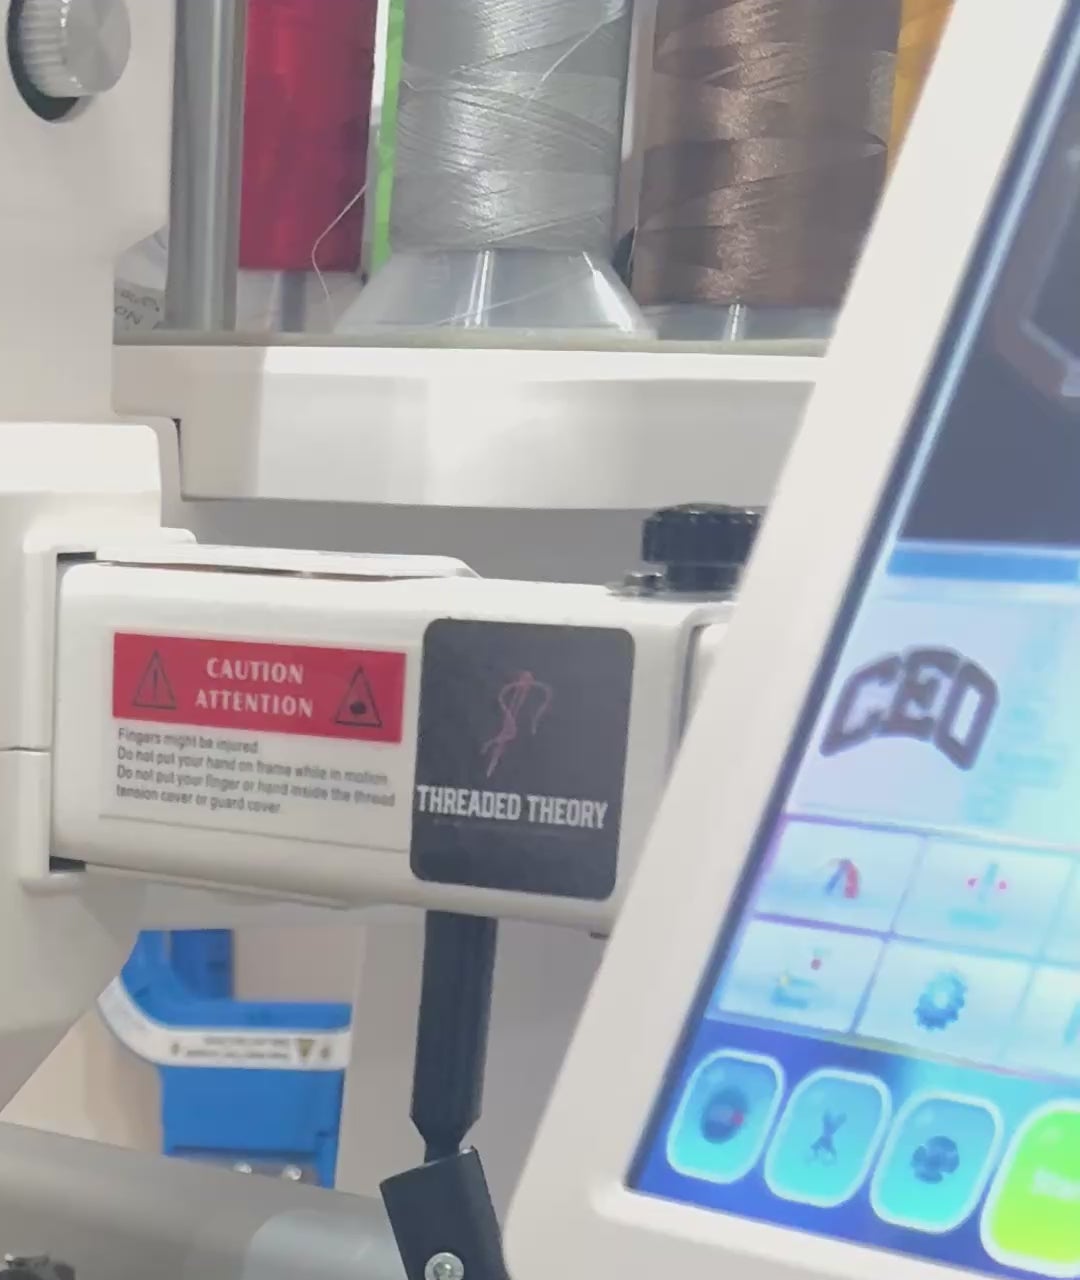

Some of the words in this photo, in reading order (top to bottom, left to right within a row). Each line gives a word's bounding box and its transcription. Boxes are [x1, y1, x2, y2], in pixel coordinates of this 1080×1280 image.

[206, 657, 304, 685] CAUTION
[195, 687, 313, 718] ATTENTION
[819, 645, 999, 771] CEO
[118, 727, 161, 746] Fingers
[199, 735, 213, 749] be
[118, 745, 133, 760] Do
[136, 750, 154, 762] not
[156, 752, 175, 765] put
[178, 755, 203, 768] your
[206, 756, 236, 770] hand
[238, 761, 253, 772] on
[117, 764, 133, 779] Do
[136, 769, 154, 780] not
[156, 771, 175, 784] put
[177, 774, 203, 788] your
[416, 785, 521, 821] THREADED
[527, 793, 608, 829] THEORY
